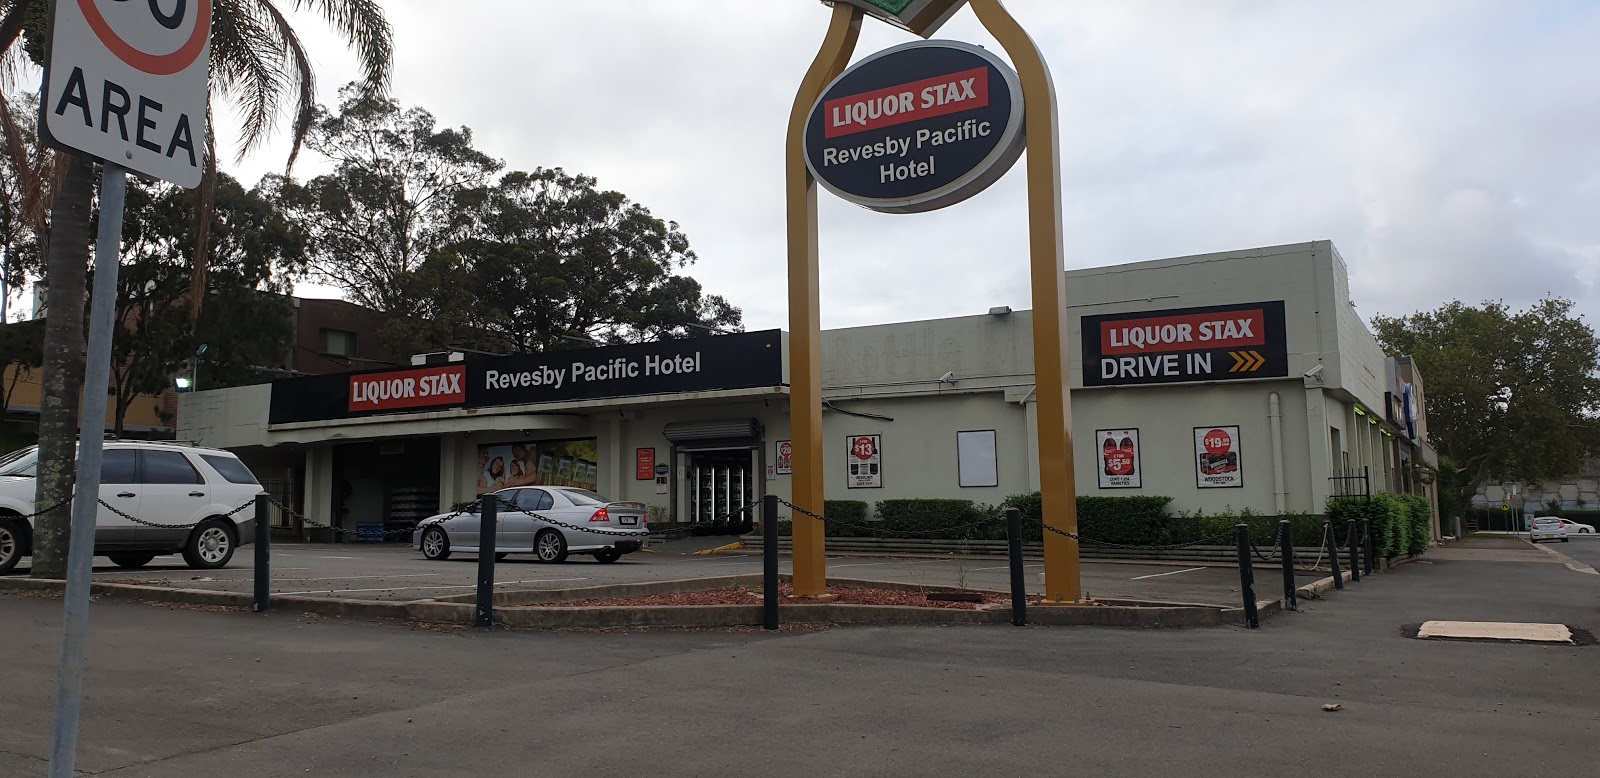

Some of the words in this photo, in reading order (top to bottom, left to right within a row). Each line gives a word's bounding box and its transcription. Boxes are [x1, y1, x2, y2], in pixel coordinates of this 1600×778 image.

[55, 66, 198, 168] AREA
[832, 91, 915, 127] LIQUOR
[920, 77, 977, 109] STAX
[823, 136, 911, 167] Revesby
[916, 119, 991, 149] Pacific
[879, 156, 935, 184] Hotel
[1110, 323, 1193, 349] LIQUOR
[1198, 318, 1255, 342] STAX
[485, 365, 566, 391] Revesby
[572, 357, 639, 382] Pacific
[645, 351, 702, 376] Hotel
[1101, 354, 1180, 379] DRIVE
[1186, 352, 1212, 375] IN
[352, 377, 416, 404] LIQUOR
[419, 373, 462, 396] STAX
[855, 443, 873, 456] $13
[1108, 458, 1130, 471] $5.50
